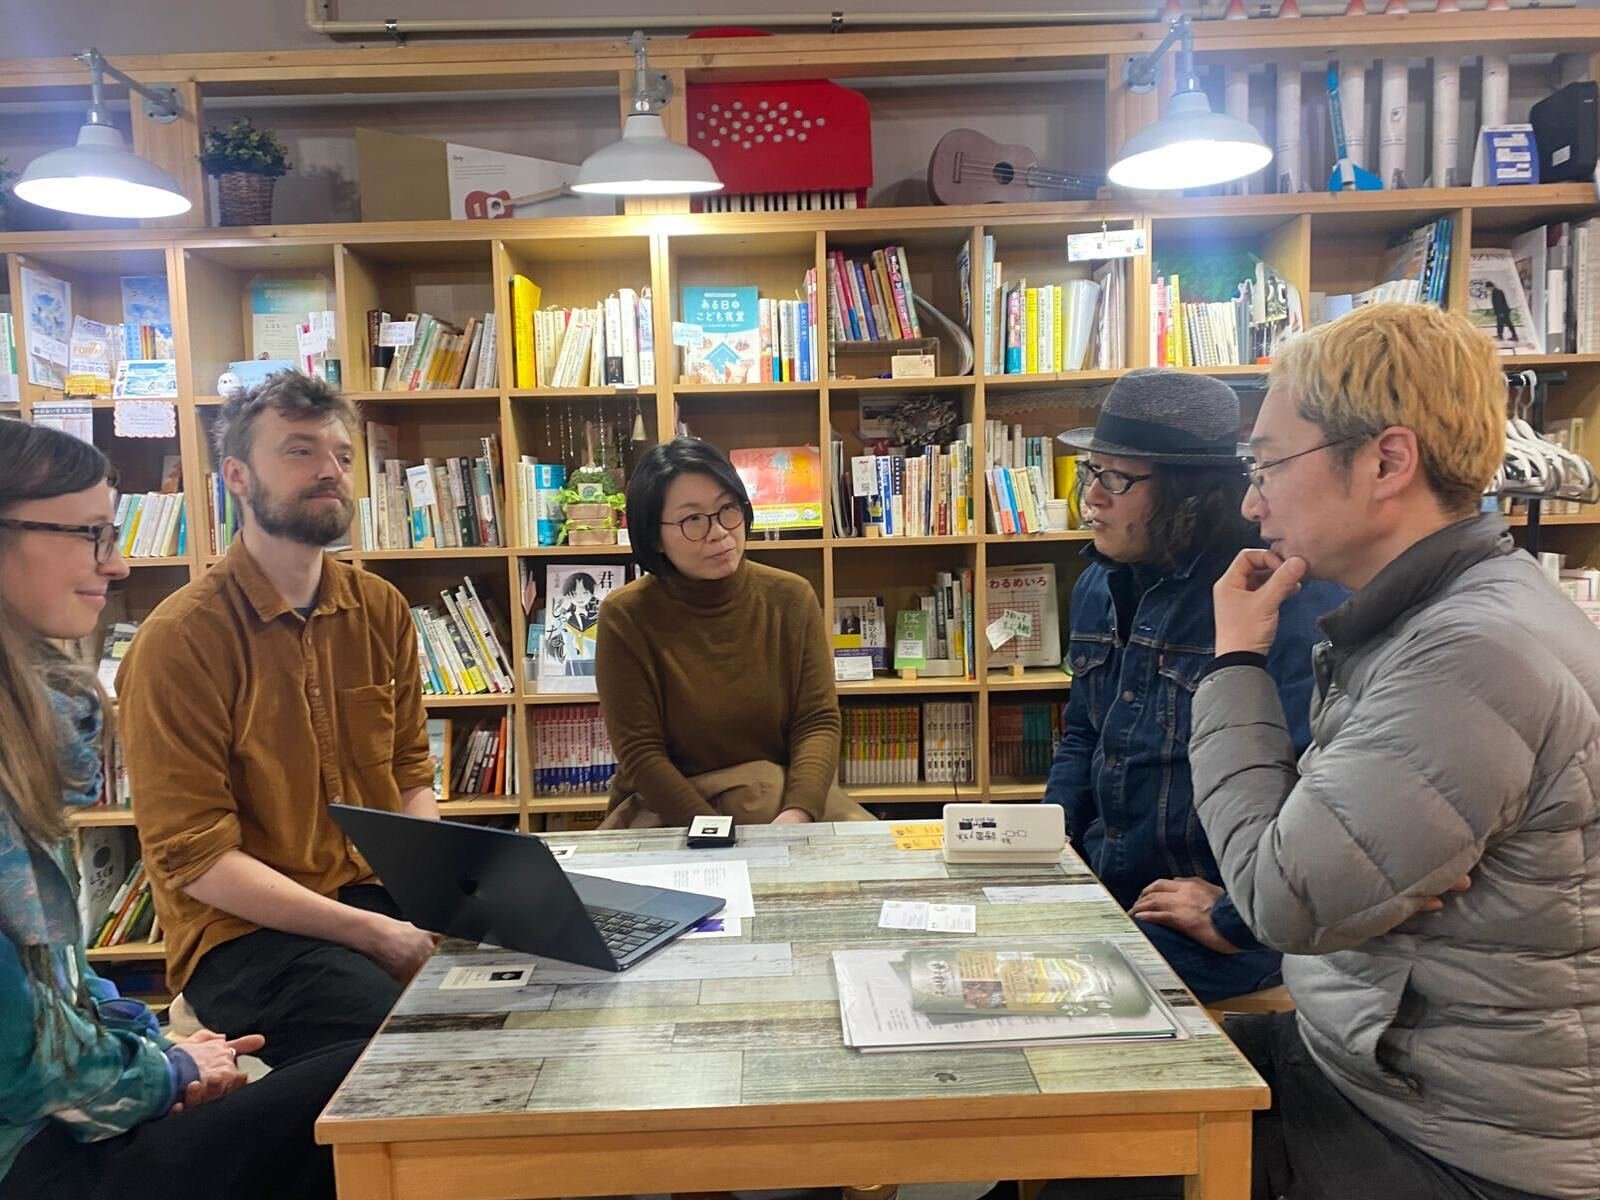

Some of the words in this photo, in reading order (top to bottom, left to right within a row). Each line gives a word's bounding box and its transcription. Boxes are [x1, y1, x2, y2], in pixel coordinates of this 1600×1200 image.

[701, 299, 740, 310] ある日の
[988, 575, 1048, 590] わるめいろ
